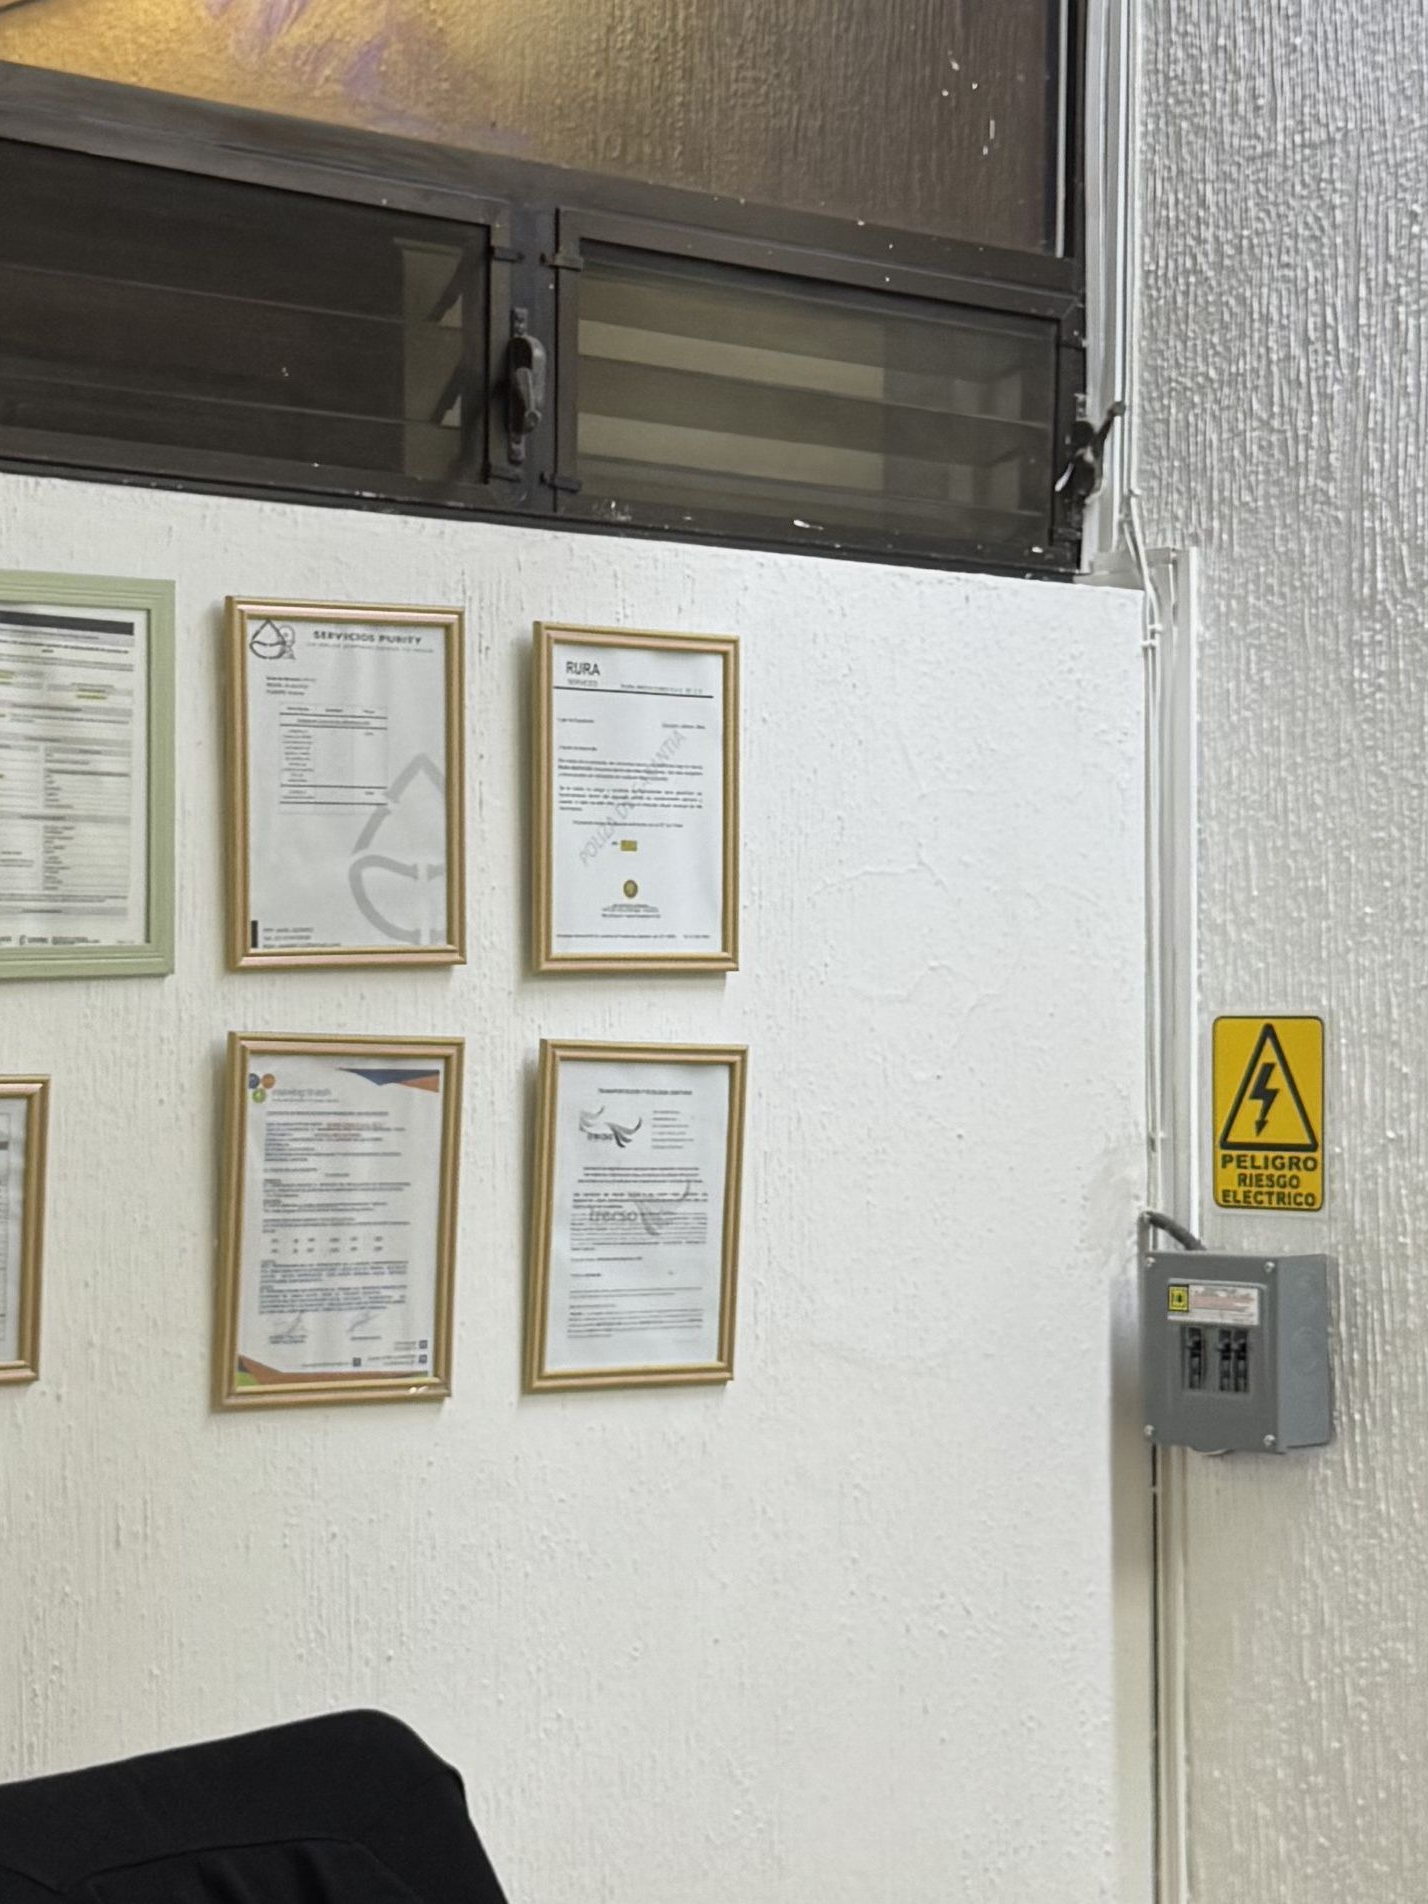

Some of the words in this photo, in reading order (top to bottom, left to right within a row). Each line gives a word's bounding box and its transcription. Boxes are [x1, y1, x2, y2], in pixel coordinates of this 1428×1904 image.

[565, 661, 600, 676] RURA
[1221, 1154, 1318, 1172] PELIGRO
[1237, 1173, 1301, 1189] RIESGO
[1221, 1189, 1315, 1207] ELECTRICO
